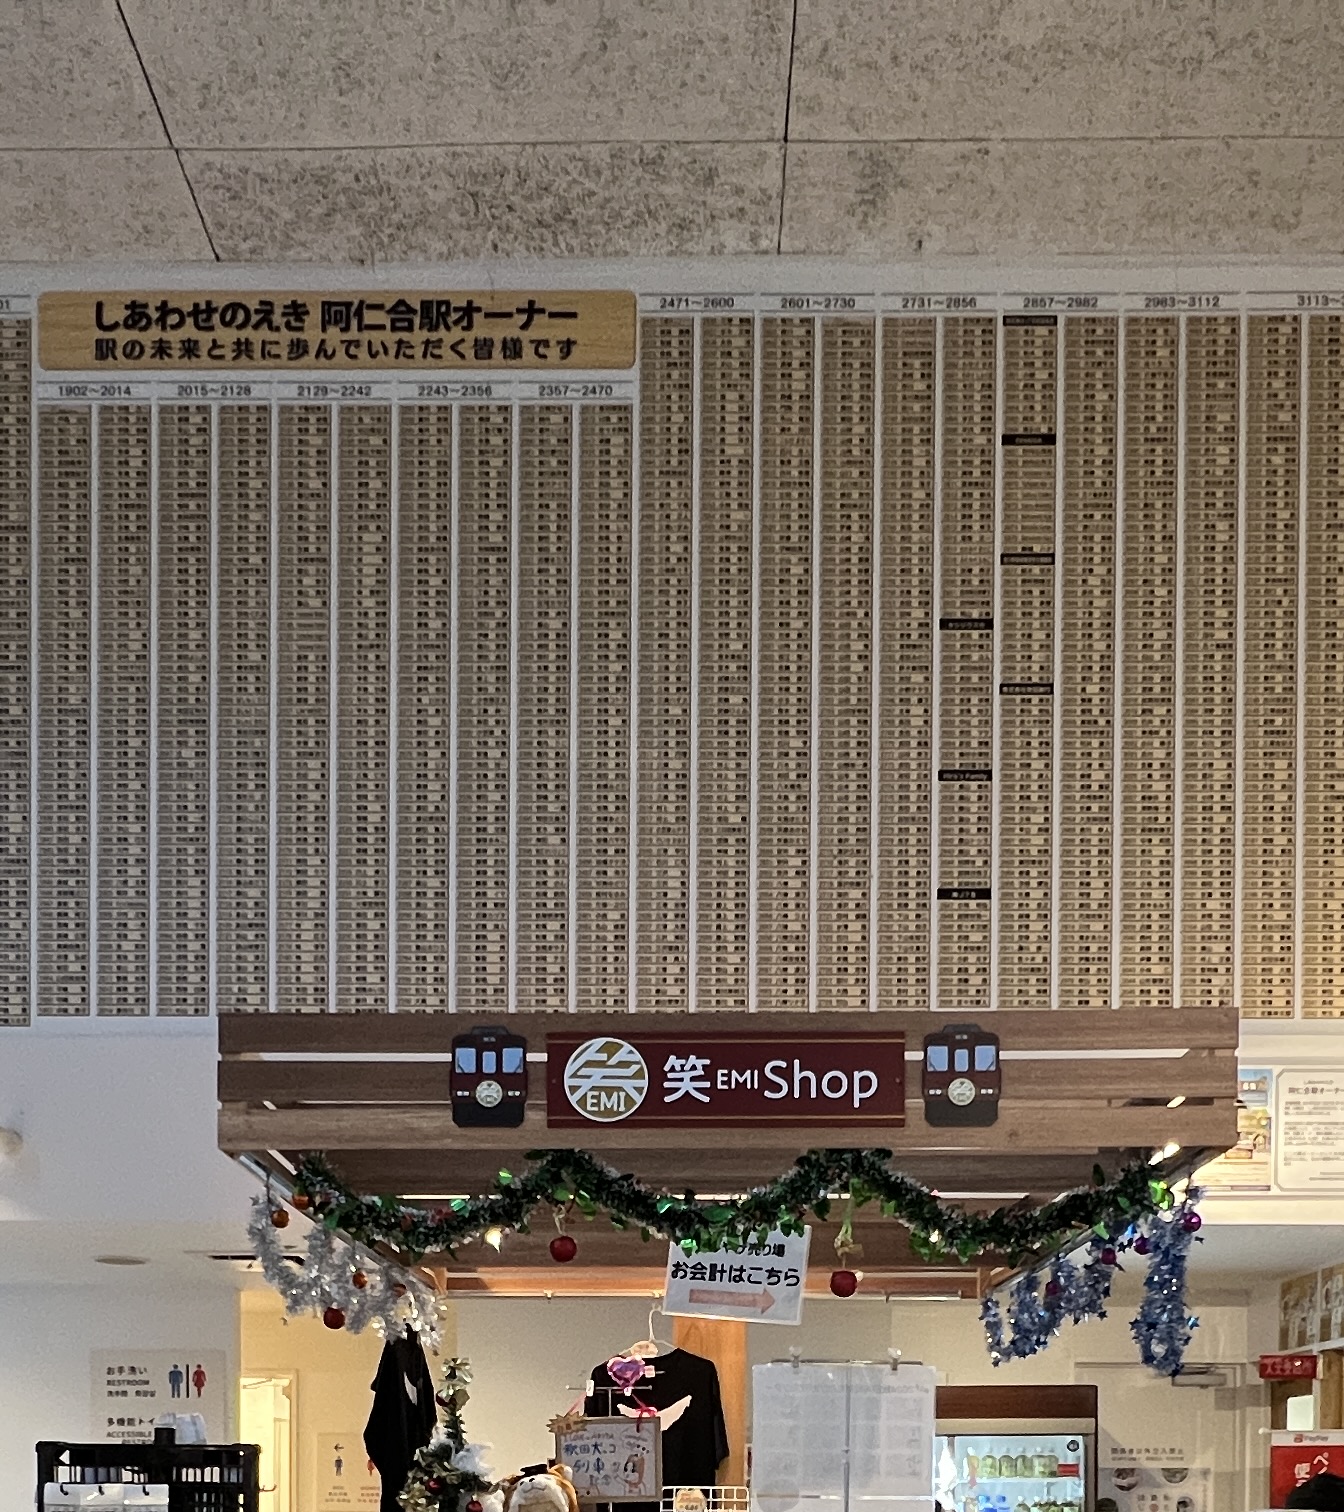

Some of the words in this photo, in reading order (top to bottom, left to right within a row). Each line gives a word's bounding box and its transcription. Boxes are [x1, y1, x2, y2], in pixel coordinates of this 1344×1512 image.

[95, 301, 310, 333] しあわせのえき
[320, 300, 580, 333] 阿仁合駅オーナー
[95, 338, 577, 362] 駅の未来と共に歩んでいただく皆様です
[663, 1054, 711, 1103] 笑
[716, 1069, 759, 1091] EMI
[763, 1059, 879, 1108] Shop
[586, 1092, 626, 1112] EMI
[671, 1260, 800, 1287] お会計はこちら
[107, 1417, 155, 1427] 多機能トイ
